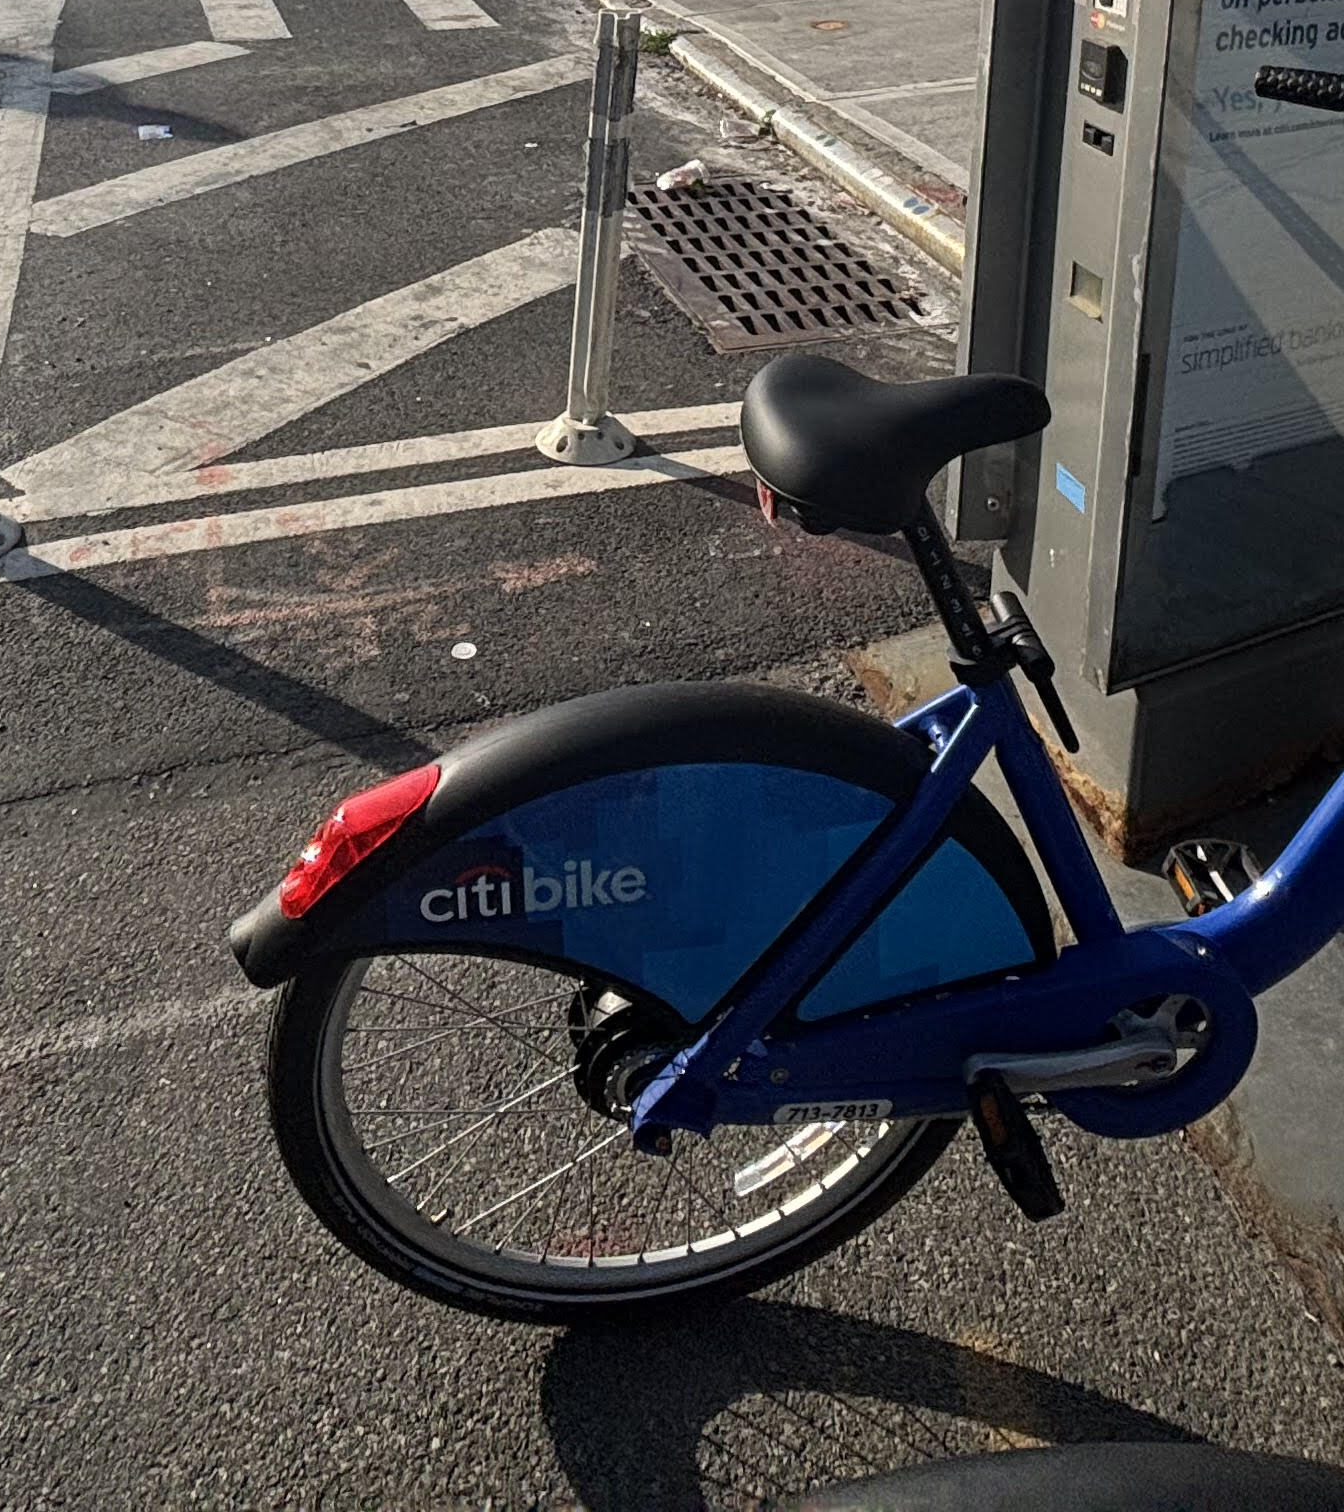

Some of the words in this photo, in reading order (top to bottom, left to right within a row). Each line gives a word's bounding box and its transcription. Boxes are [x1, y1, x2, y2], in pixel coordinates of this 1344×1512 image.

[1215, 17, 1318, 52] checking
[1181, 335, 1282, 375] simplified
[787, 1104, 878, 1121] 713-7813
